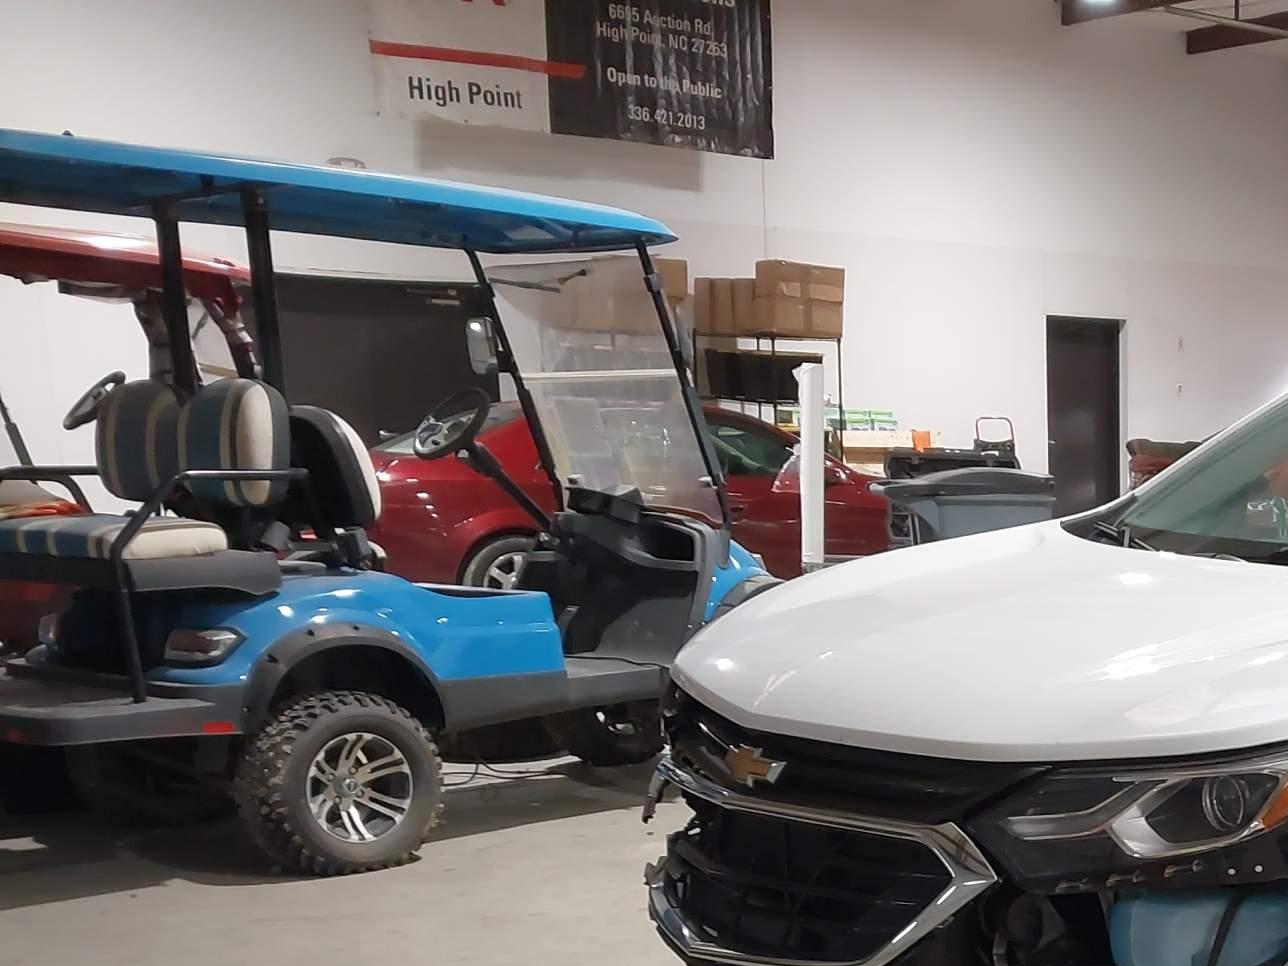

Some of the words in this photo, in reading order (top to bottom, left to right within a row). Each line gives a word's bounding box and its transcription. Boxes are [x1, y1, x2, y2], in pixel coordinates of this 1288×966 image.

[643, 9, 691, 33] Auction
[597, 22, 627, 42] High
[669, 34, 688, 50] NC
[691, 38, 728, 58] 27263
[408, 76, 461, 107] High
[467, 81, 523, 109] Point
[606, 67, 641, 87] Open
[644, 74, 657, 88] to
[682, 79, 723, 98] Public
[628, 105, 705, 130] 336.421.2013
